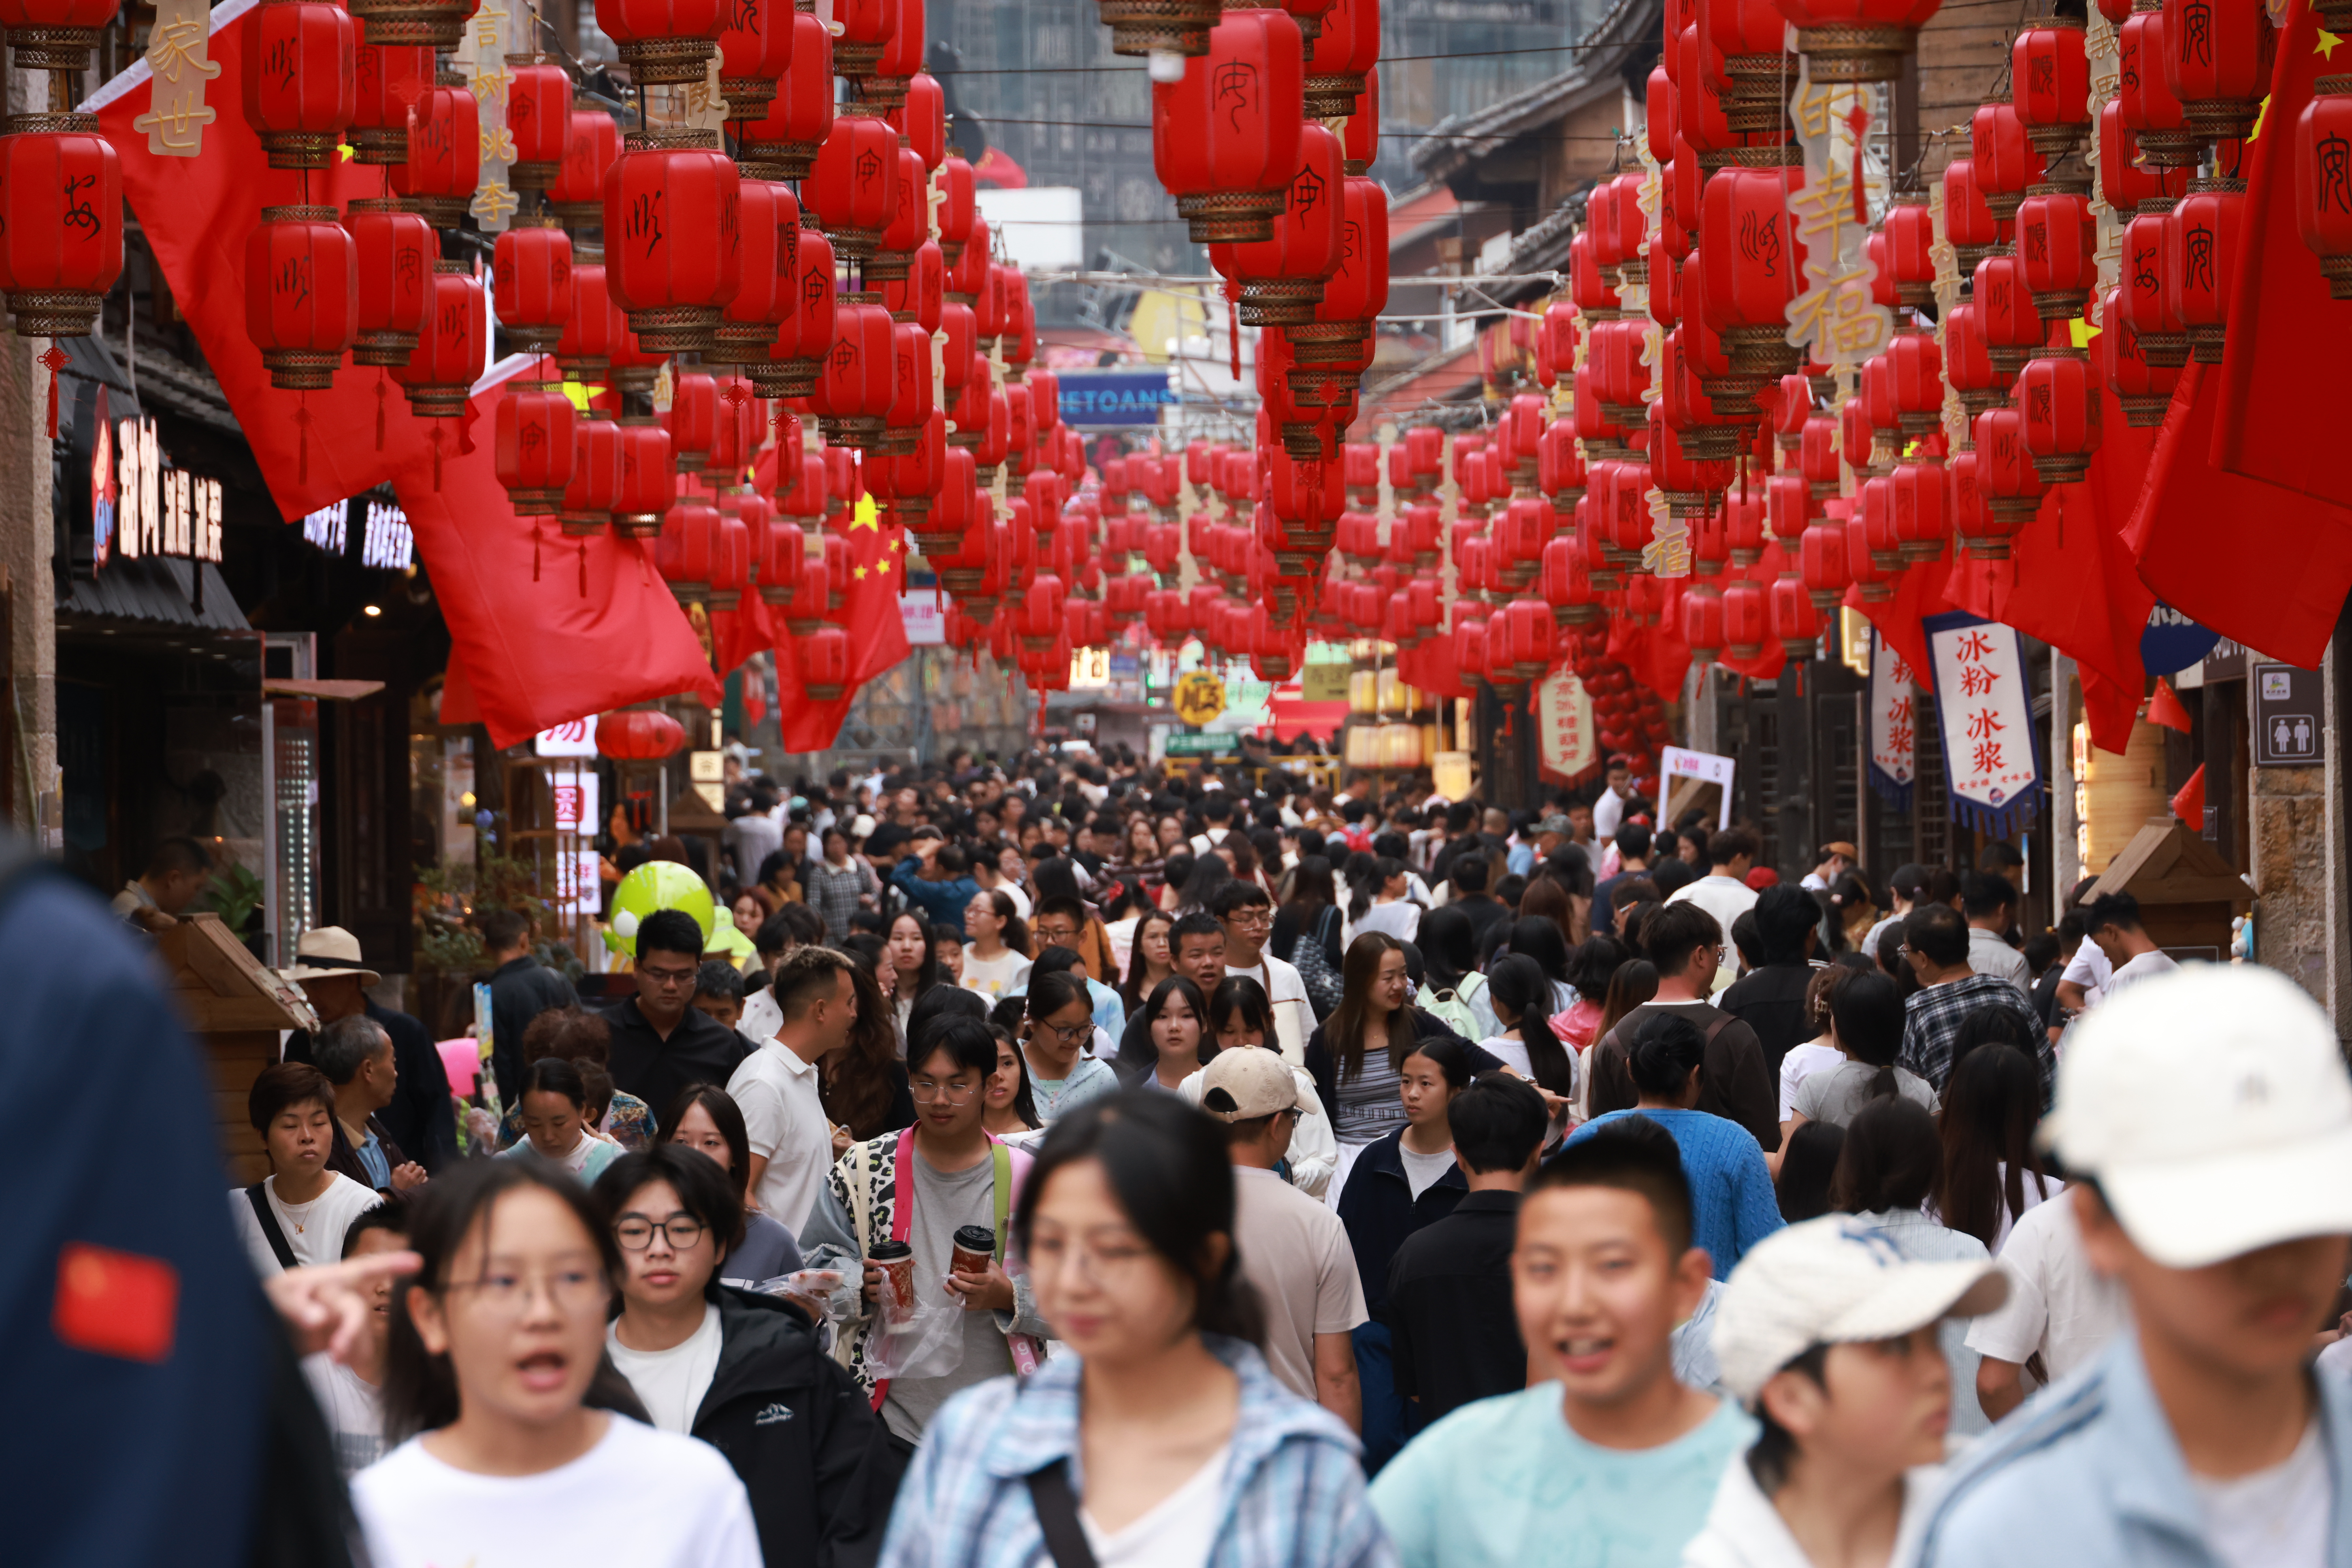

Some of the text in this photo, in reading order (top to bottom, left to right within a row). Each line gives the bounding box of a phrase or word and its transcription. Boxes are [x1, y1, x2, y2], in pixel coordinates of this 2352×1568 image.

[2182, 0, 2211, 67] 安
[142, 13, 217, 148] 家世
[2316, 131, 2352, 213] 安
[2186, 222, 2214, 292] 安
[1956, 630, 2016, 774] 冰粉 冰浆
